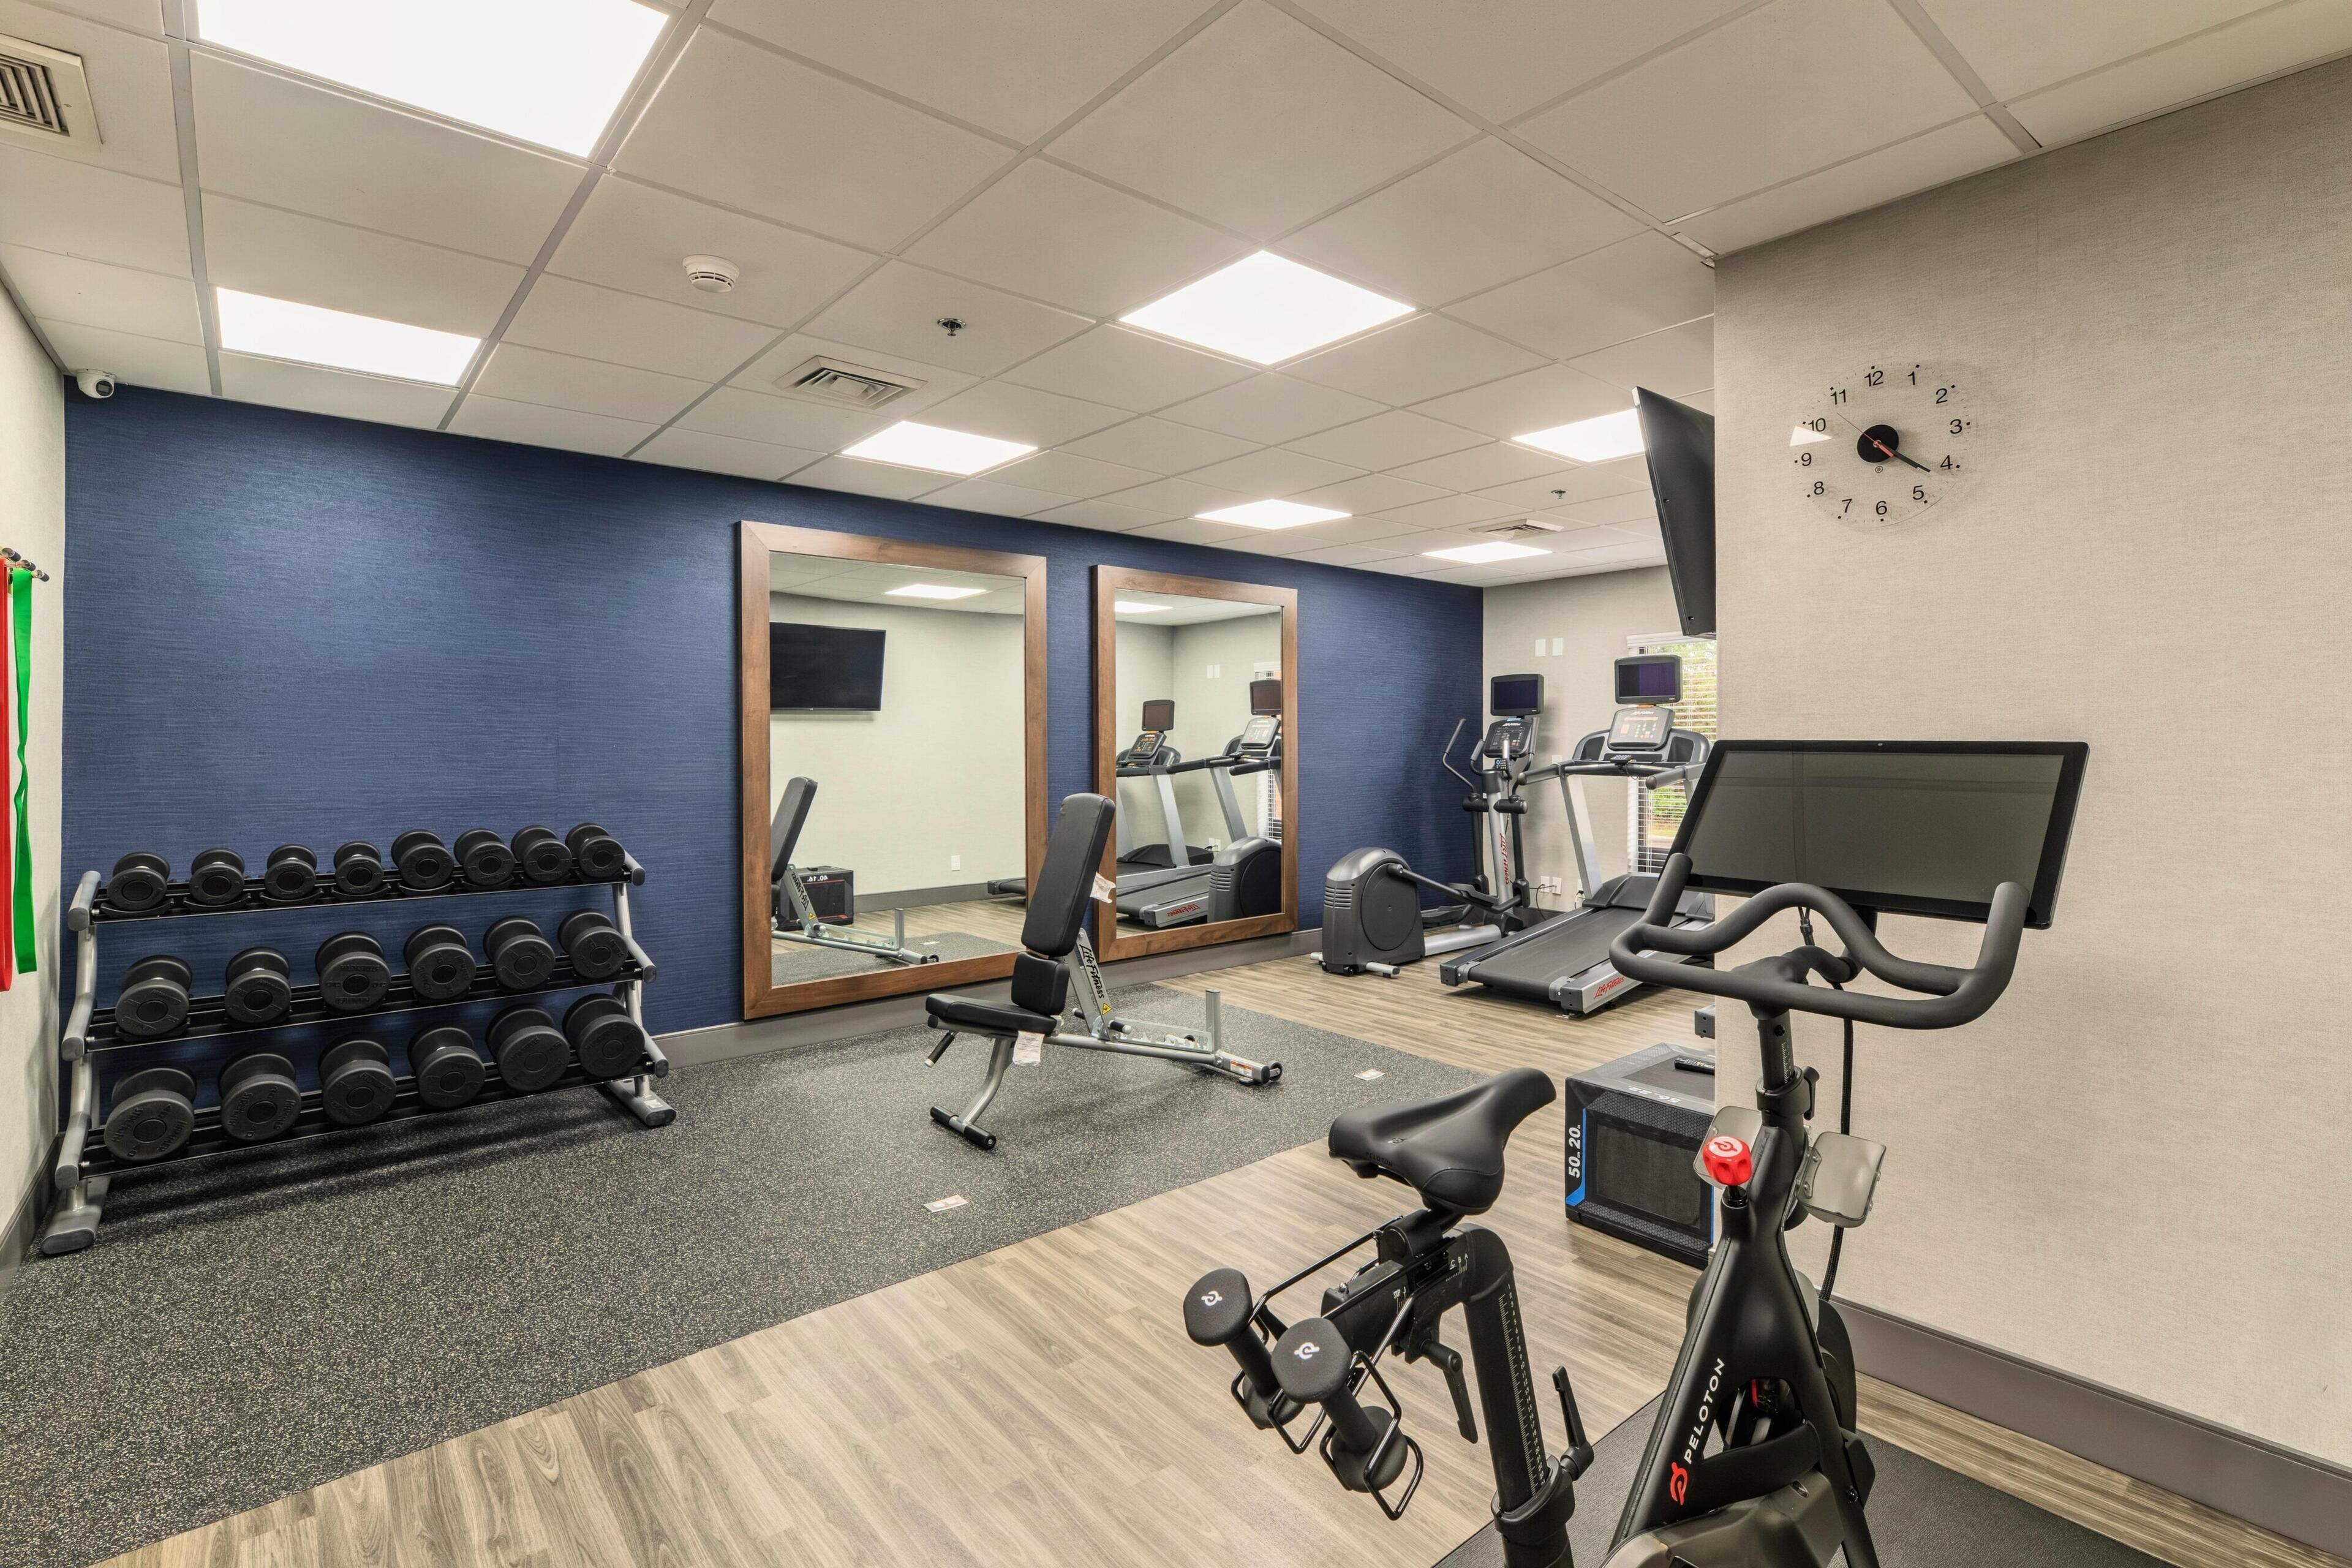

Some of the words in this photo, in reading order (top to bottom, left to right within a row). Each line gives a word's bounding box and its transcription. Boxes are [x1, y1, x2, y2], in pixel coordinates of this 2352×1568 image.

[1864, 371, 1883, 386] 12
[1908, 371, 1916, 385] 1
[1830, 389, 1847, 405] 11
[1936, 388, 1948, 404] 2
[1807, 418, 1826, 432] 10
[1950, 419, 1962, 434] 3
[1801, 453, 1812, 466] 9
[1940, 455, 1953, 470] 4
[1814, 481, 1825, 495] 8
[1913, 485, 1924, 500] 5
[1842, 499, 1852, 513] 7
[1875, 501, 1888, 515] 6
[1684, 1358, 1725, 1464] PELOTON
